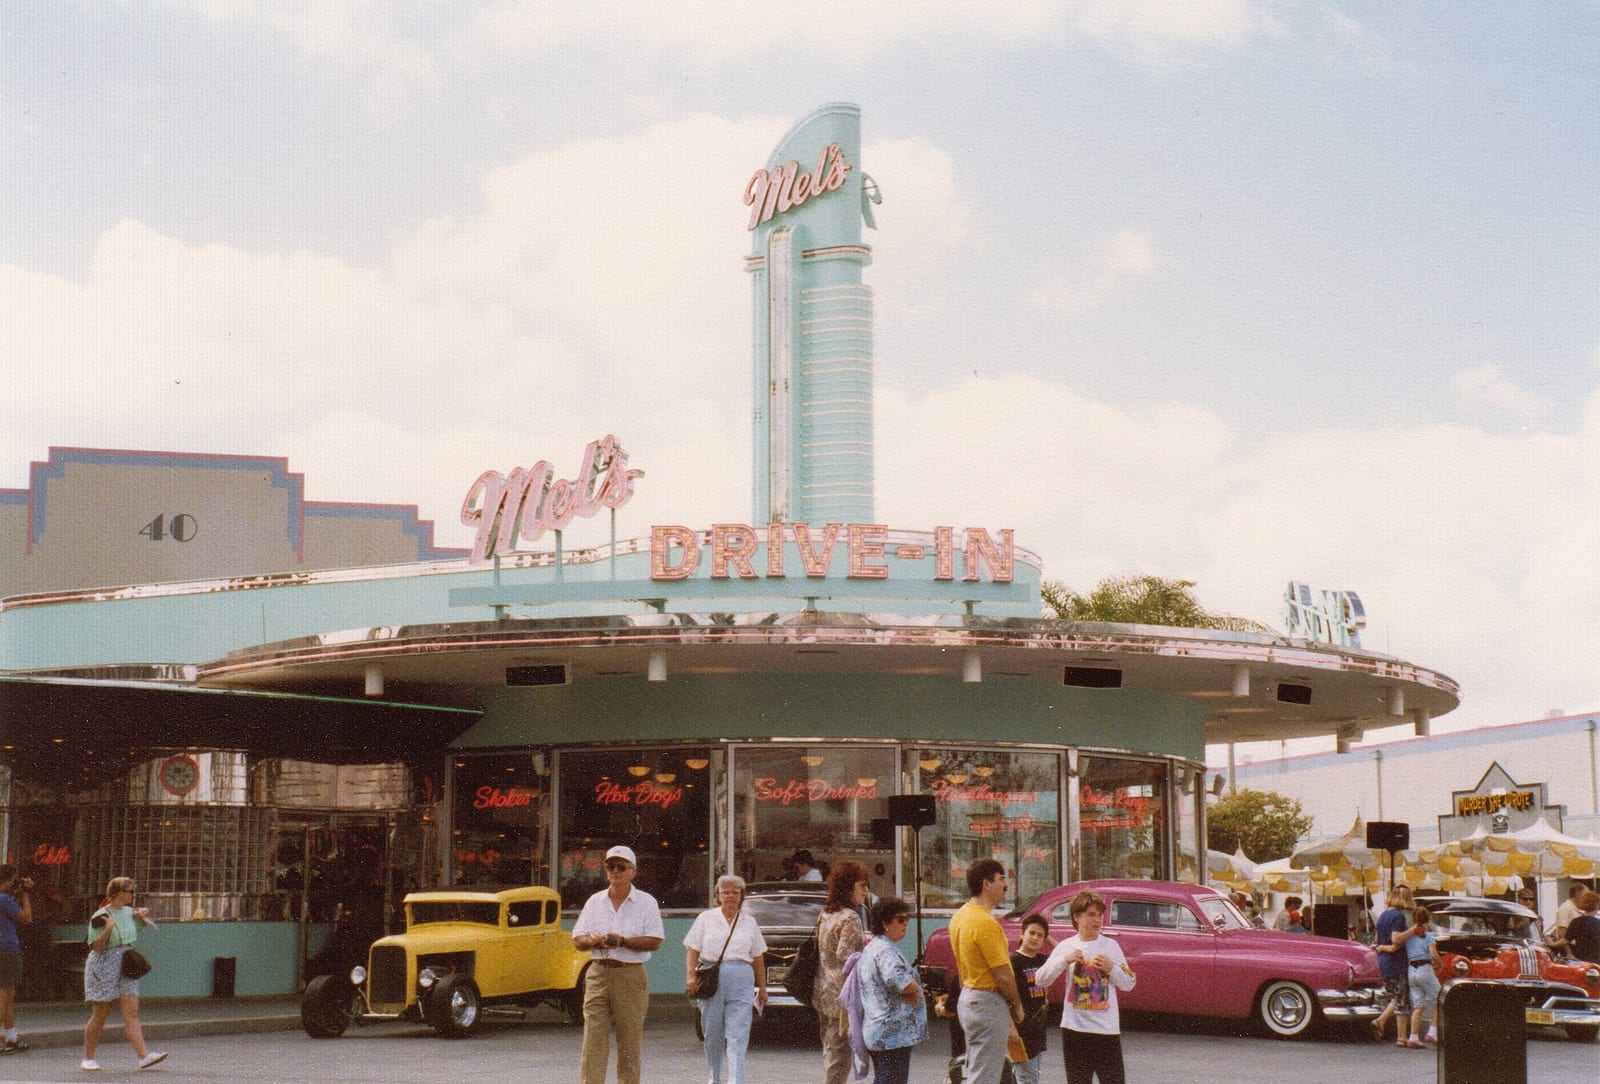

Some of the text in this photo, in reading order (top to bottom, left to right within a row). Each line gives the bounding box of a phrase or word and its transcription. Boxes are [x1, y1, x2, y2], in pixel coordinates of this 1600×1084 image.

[743, 142, 852, 231] Mel's
[462, 434, 645, 562] Mel's
[139, 513, 198, 542] 40
[651, 523, 1015, 583] DRIVE-IN
[473, 786, 531, 809] Shakes
[595, 781, 682, 809] Hot Dogs
[754, 778, 878, 805] Soft Drinks
